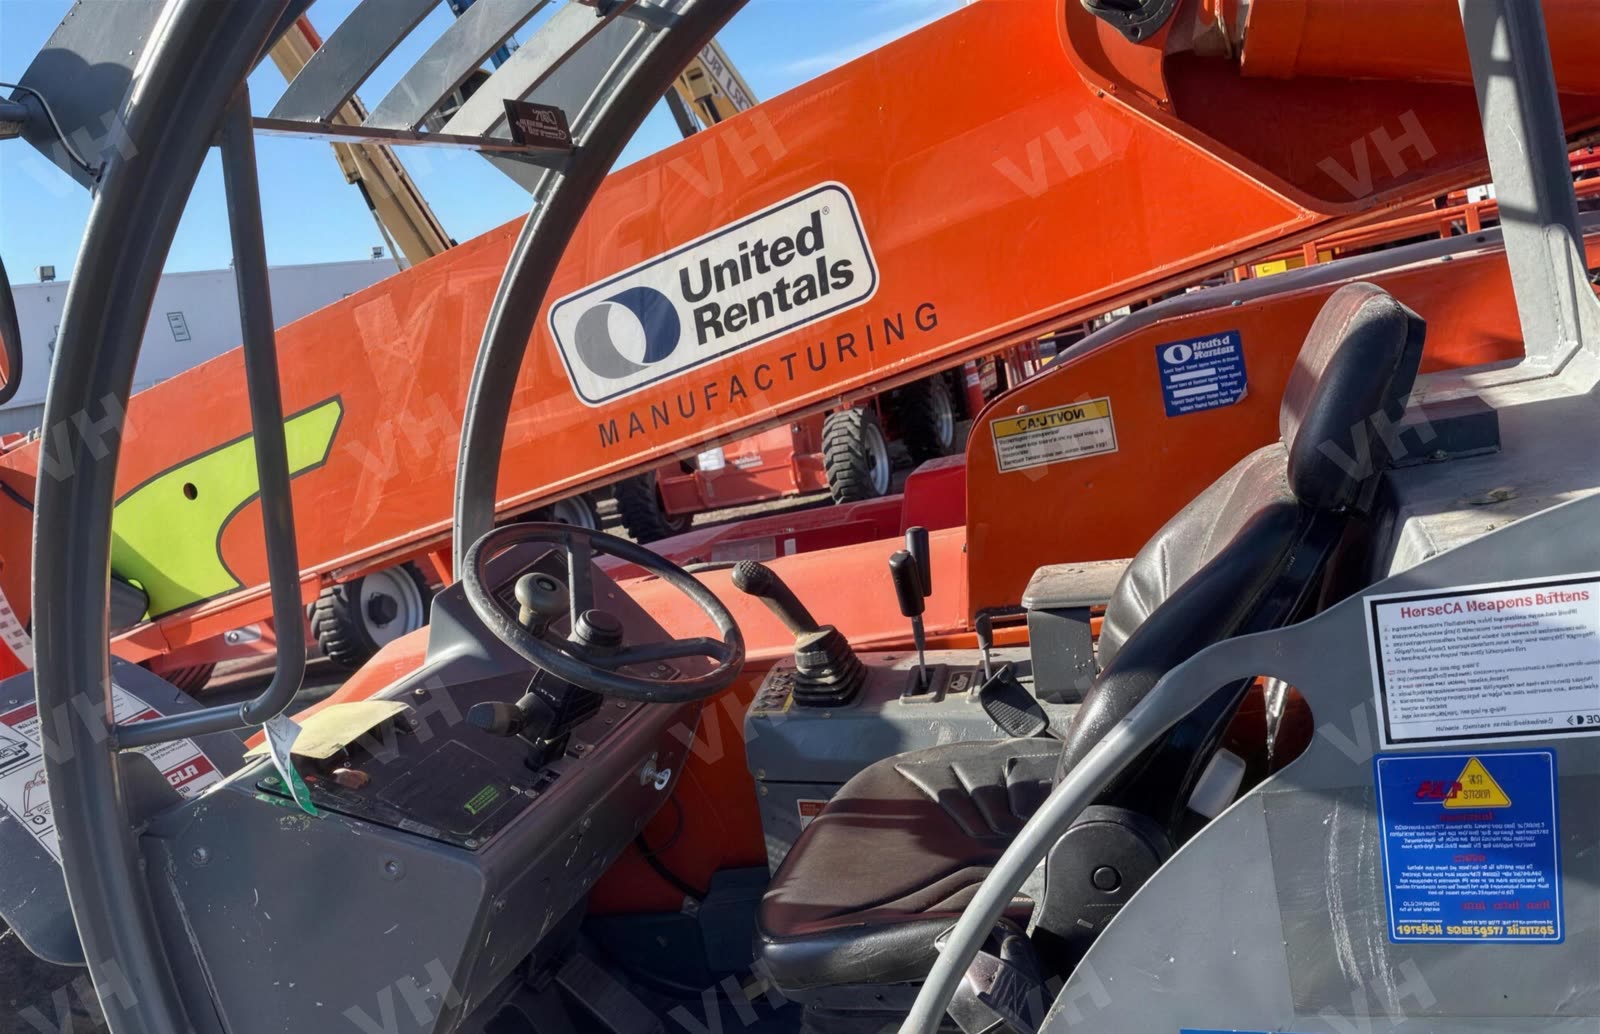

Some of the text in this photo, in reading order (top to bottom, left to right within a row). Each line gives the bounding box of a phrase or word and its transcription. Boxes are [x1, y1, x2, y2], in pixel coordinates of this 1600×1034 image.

[679, 209, 826, 304] United
[692, 256, 855, 346] Rentals
[598, 301, 939, 448] MANUFACTURING
